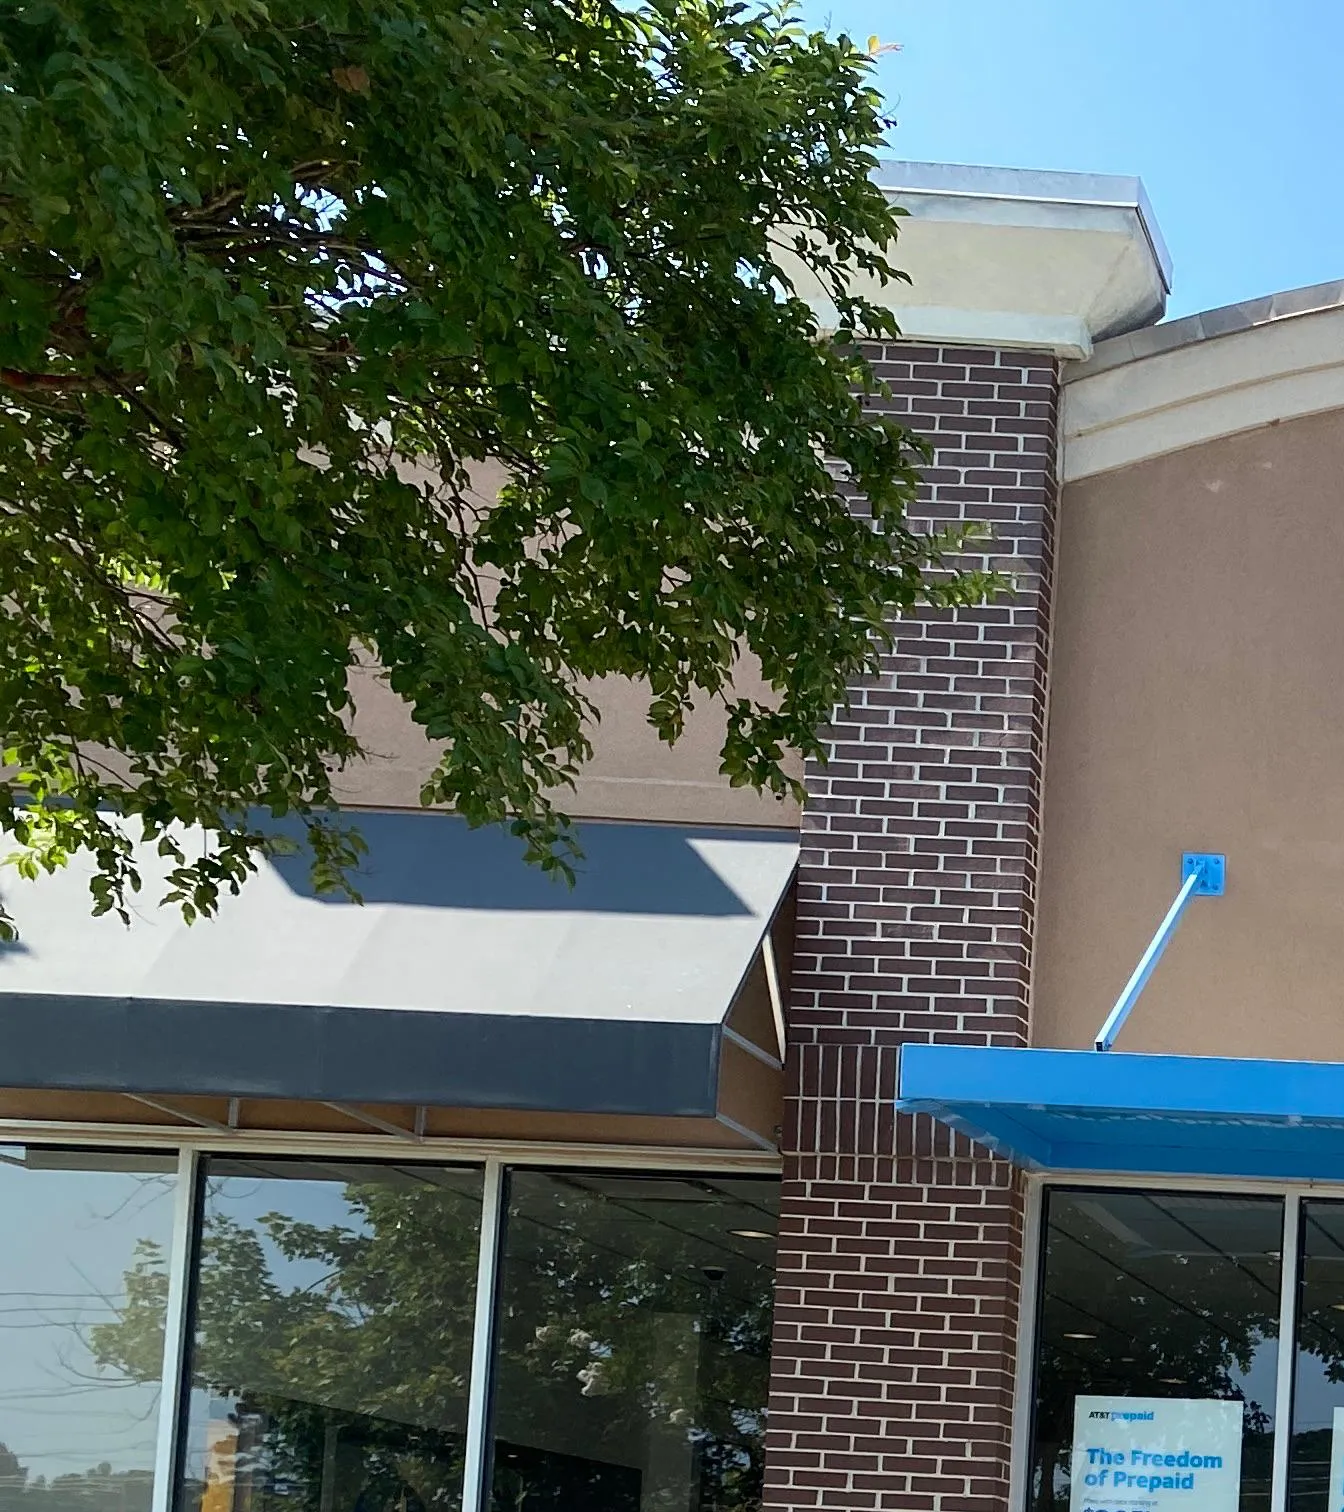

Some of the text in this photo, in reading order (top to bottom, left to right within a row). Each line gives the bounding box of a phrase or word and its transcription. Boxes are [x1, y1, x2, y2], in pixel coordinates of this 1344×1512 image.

[1088, 1411, 1154, 1422] AT&T prepaid
[1086, 1448, 1222, 1468] The Freedom
[1084, 1469, 1194, 1492] of Prepaid
